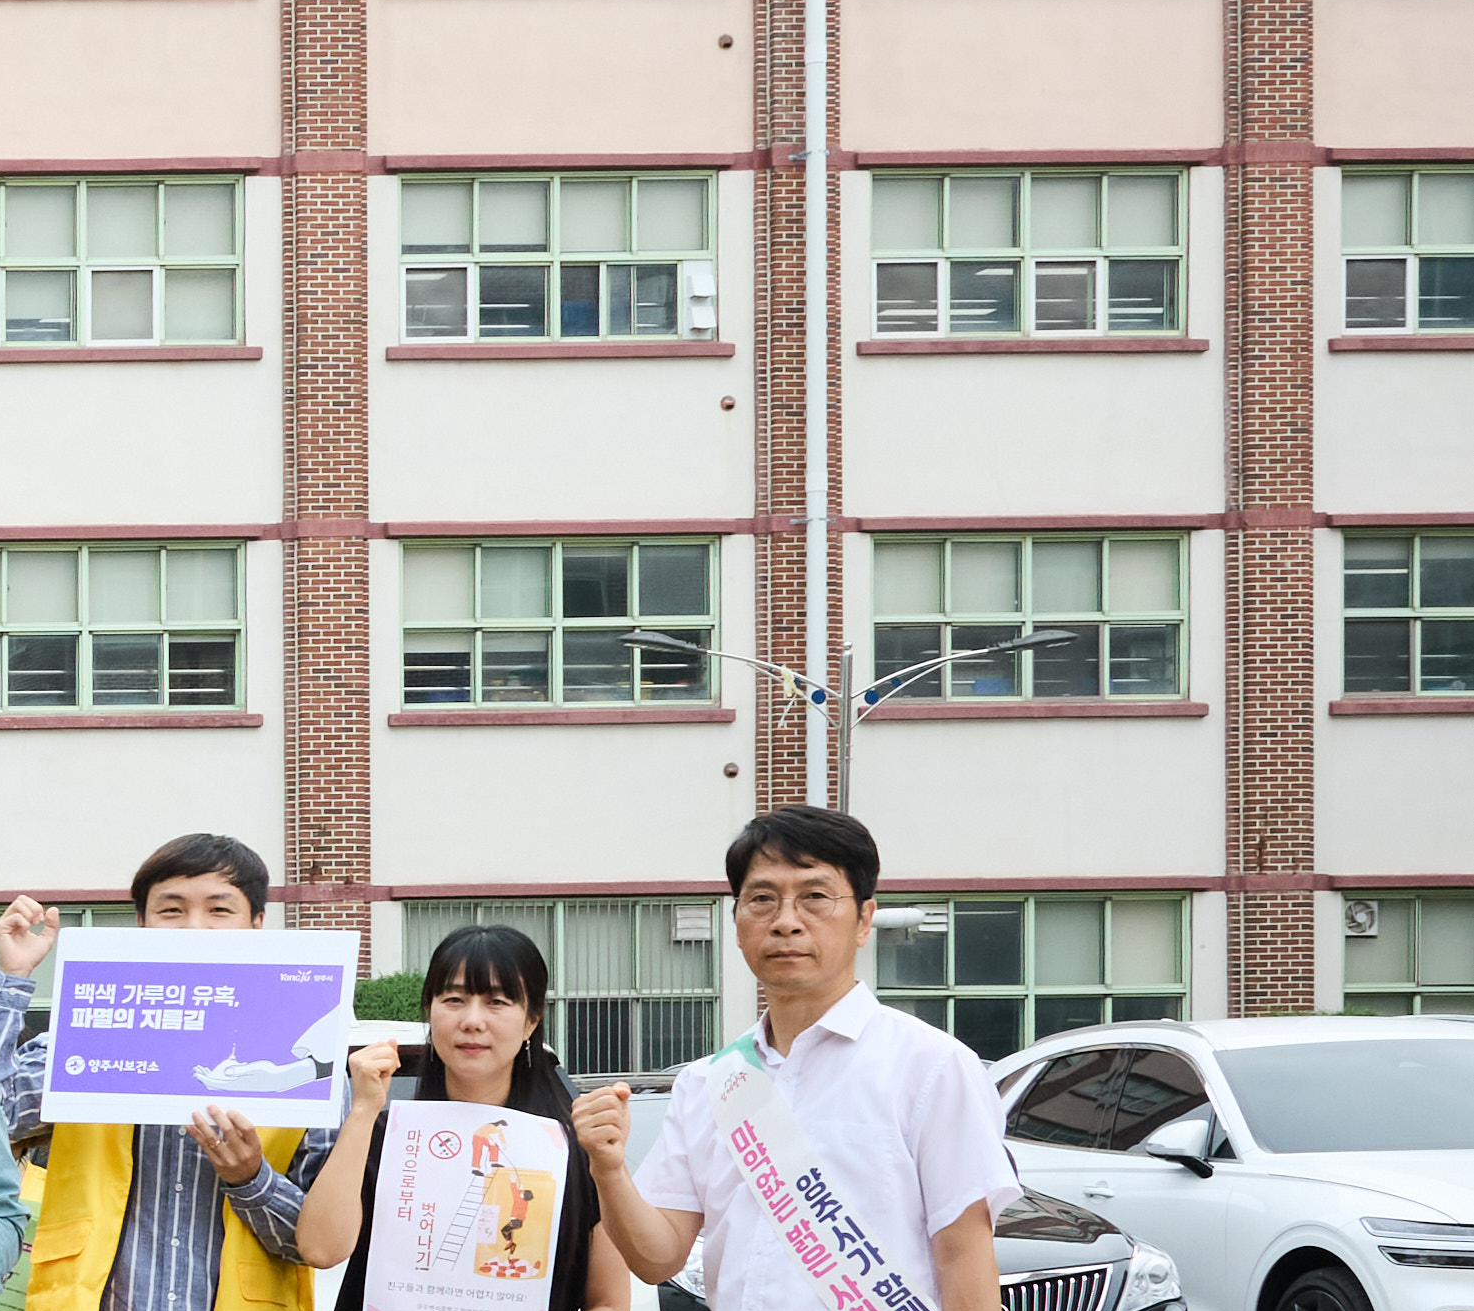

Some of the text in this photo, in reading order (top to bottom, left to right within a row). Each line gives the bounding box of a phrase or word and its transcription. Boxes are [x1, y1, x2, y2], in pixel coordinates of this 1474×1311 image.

[70, 1008, 205, 1031] 파멸의 지름길
[74, 983, 240, 1008] 백색 가루의 유혹,
[88, 1059, 160, 1074] 양주시보건소
[397, 1129, 422, 1222] 마약으로부터
[731, 1121, 798, 1224] 마약없는
[415, 1202, 436, 1272] 벗어나기!
[796, 1167, 885, 1276] 양주시가
